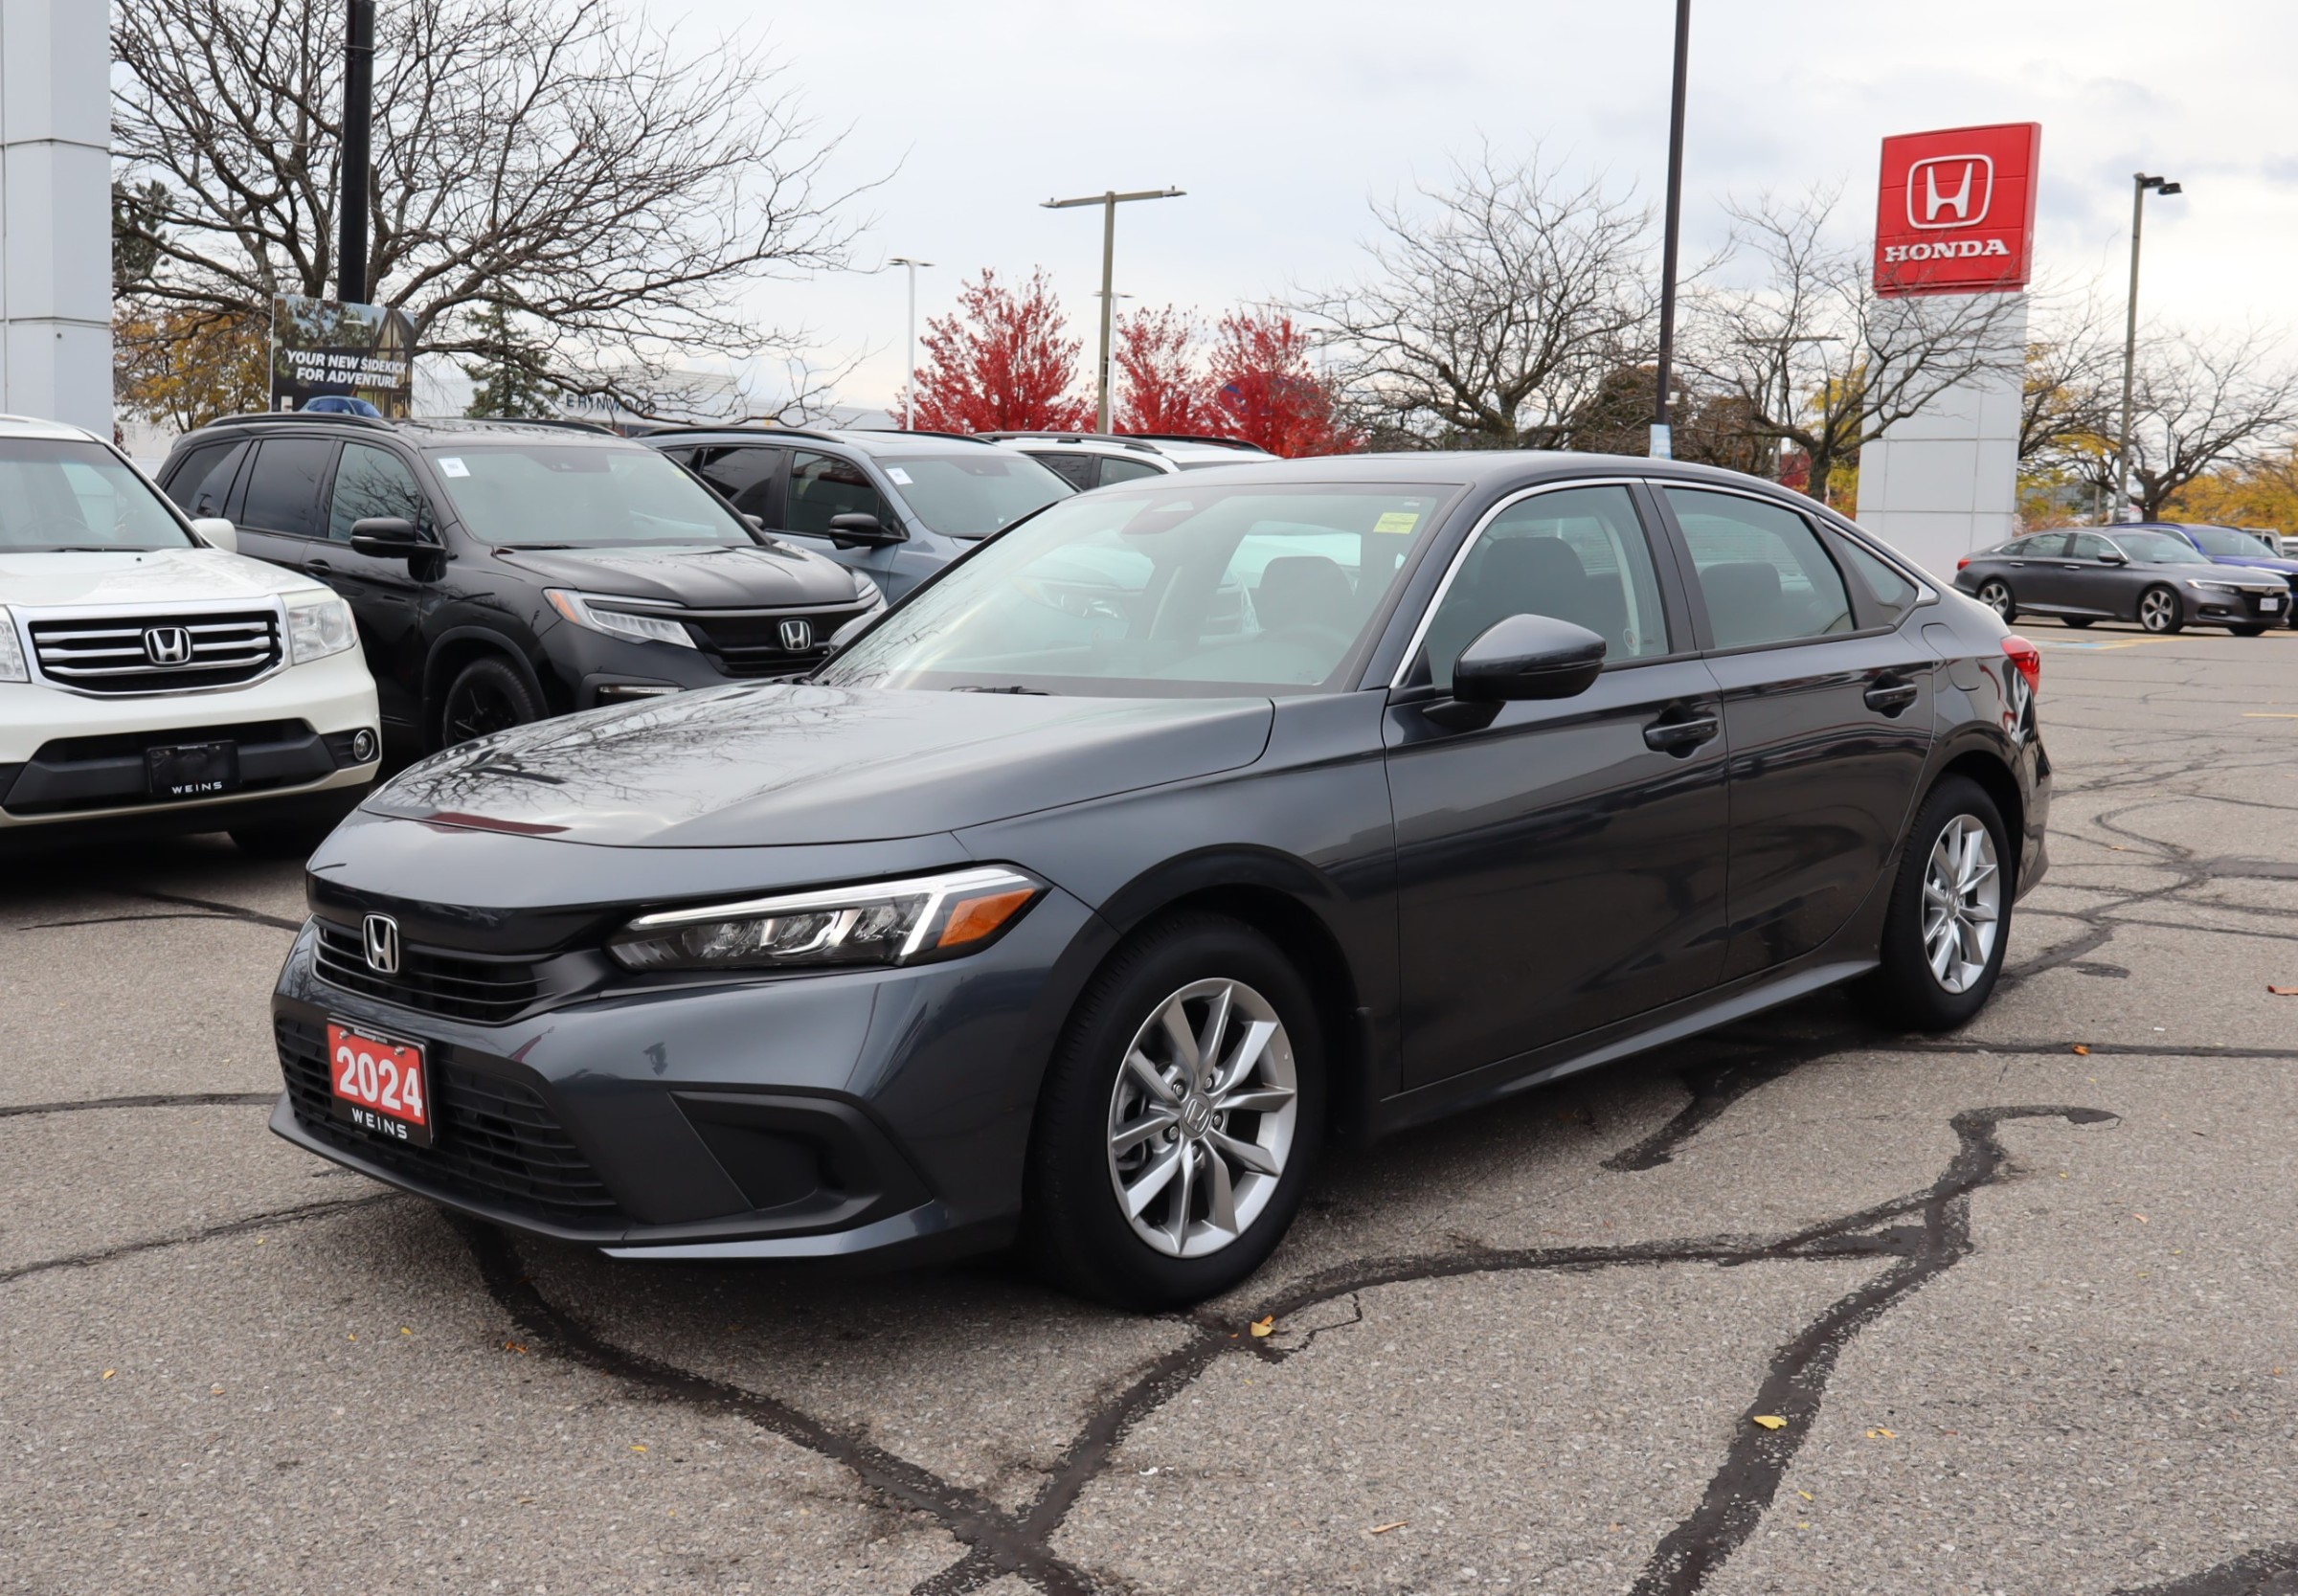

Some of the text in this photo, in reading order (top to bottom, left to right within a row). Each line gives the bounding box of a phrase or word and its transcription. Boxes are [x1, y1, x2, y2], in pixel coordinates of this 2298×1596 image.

[1884, 239, 2010, 262] HONDA
[287, 350, 407, 374] YOUR NEW SIDEKICK
[296, 368, 399, 389] FOR ADVENTURE.
[171, 781, 222, 794] WEINS
[336, 1045, 423, 1118] 2024
[351, 1108, 408, 1139] WEINS
